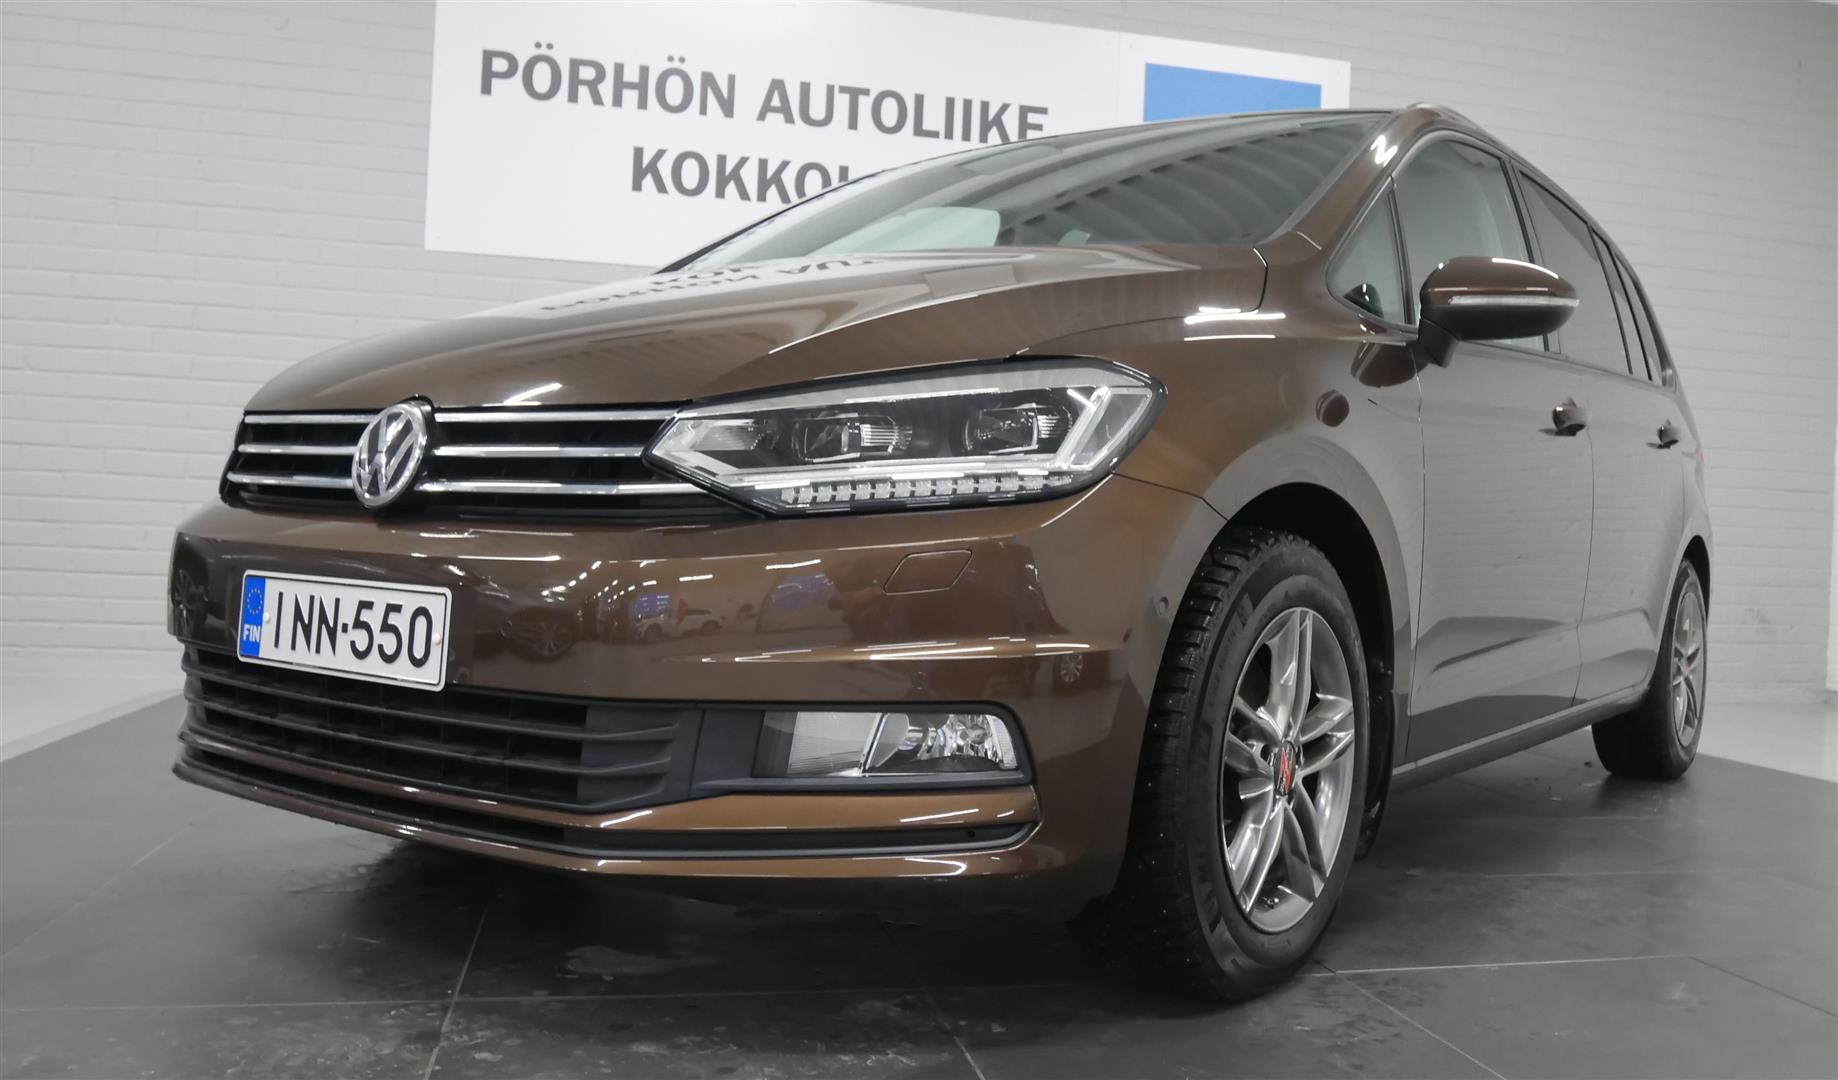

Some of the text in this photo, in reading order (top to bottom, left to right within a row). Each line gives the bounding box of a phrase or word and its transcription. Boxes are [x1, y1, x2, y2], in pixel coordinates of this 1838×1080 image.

[480, 41, 1048, 144] PÖRHÖN AUTOLIIKE
[243, 624, 261, 643] FIN
[274, 591, 433, 668] INN-550
